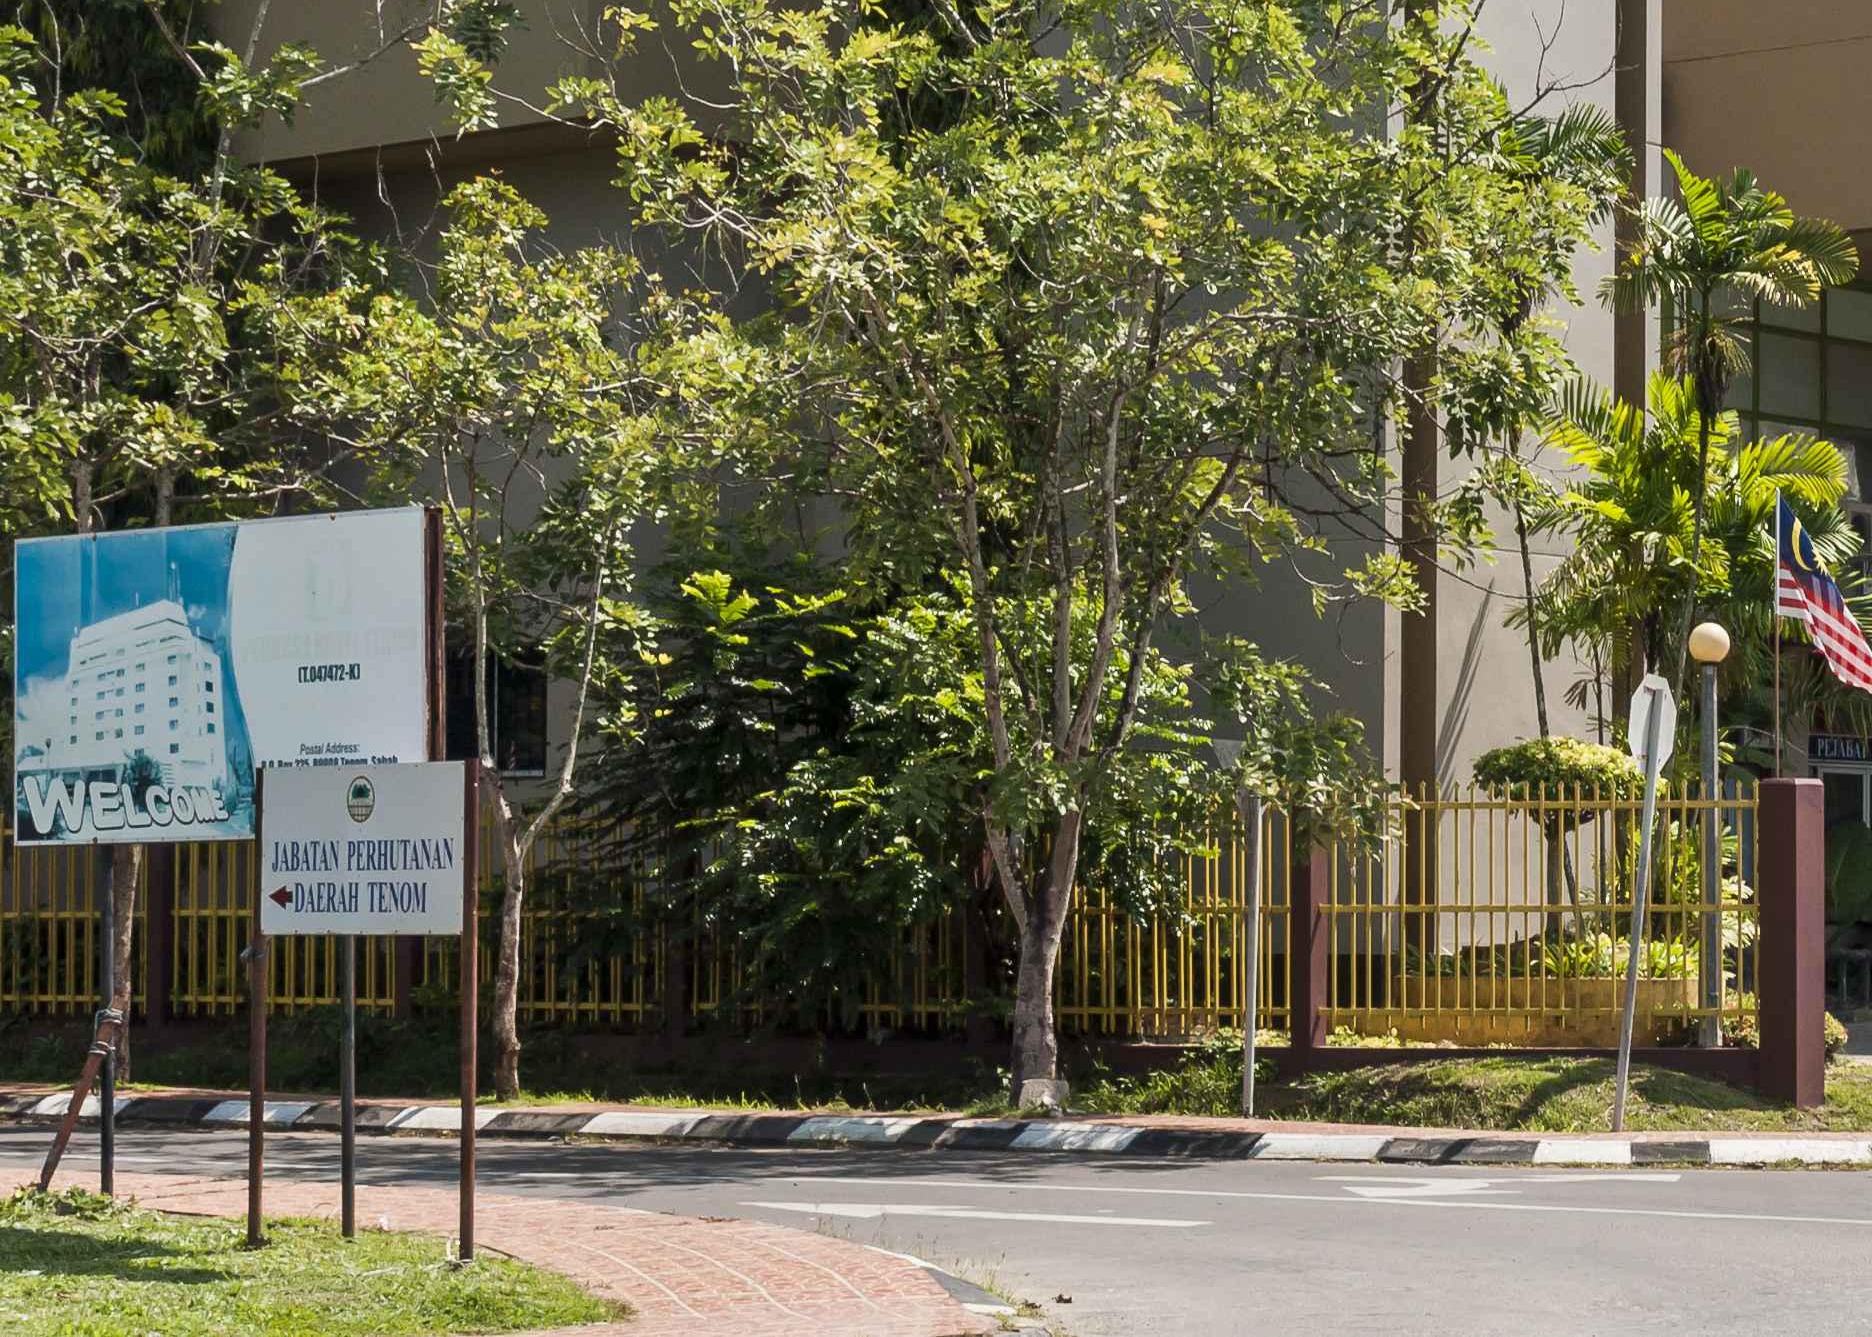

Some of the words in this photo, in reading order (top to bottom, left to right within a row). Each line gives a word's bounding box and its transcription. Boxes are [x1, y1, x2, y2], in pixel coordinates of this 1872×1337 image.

[299, 743, 324, 756] Postal
[325, 742, 361, 754] Address:
[371, 754, 399, 765] Sabah
[23, 774, 229, 834] WELCOME
[271, 841, 340, 873] JABATAN
[347, 837, 454, 872] PERHUTANAN
[294, 881, 359, 913] DAERAH
[367, 881, 427, 913] TENOM
